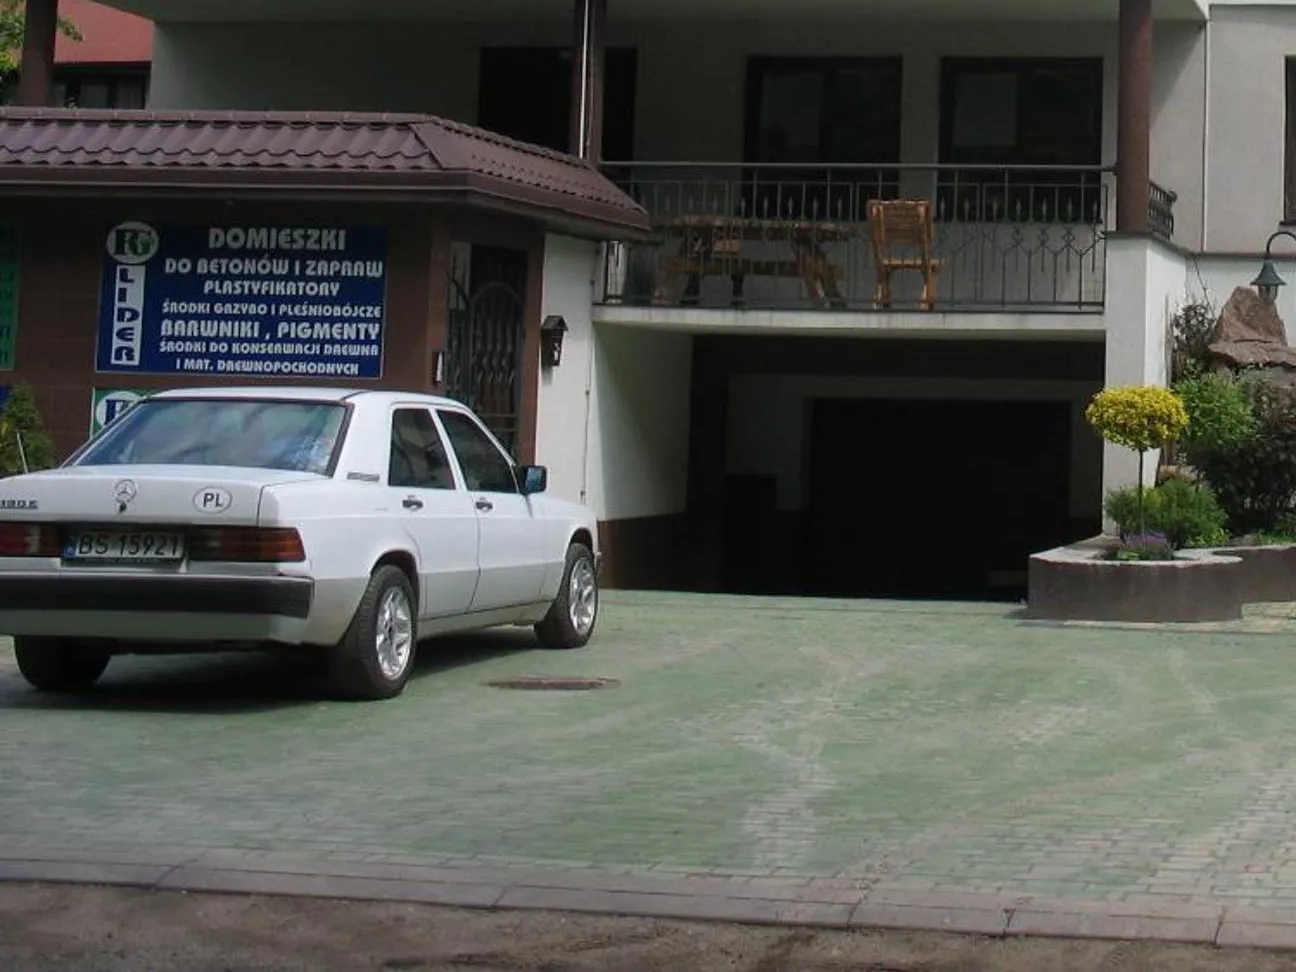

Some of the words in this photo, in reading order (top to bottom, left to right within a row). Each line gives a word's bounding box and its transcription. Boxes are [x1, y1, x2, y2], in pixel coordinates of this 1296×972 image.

[208, 228, 347, 251] DOMIESZKI
[164, 259, 193, 274] DO
[197, 255, 289, 276] BETONÓW
[295, 260, 300, 276] I
[305, 260, 383, 278] ZAPRAW
[203, 281, 340, 296] PLASTYFIKATORY
[114, 268, 140, 361] LIDER
[162, 301, 210, 314] ŚRODKI
[214, 303, 267, 316] GRZYBO
[277, 323, 380, 341] PIGMENTY
[160, 340, 206, 353] ŚRODKI
[209, 342, 228, 354] DO
[232, 342, 321, 355] KONSERWACJI
[323, 344, 379, 356] DREWNA
[184, 359, 214, 371] MAT.
[217, 360, 359, 375] DREWNOPOCHODNYCH
[203, 492, 224, 508] PL
[79, 534, 108, 555] BS
[120, 534, 178, 557] 15921
